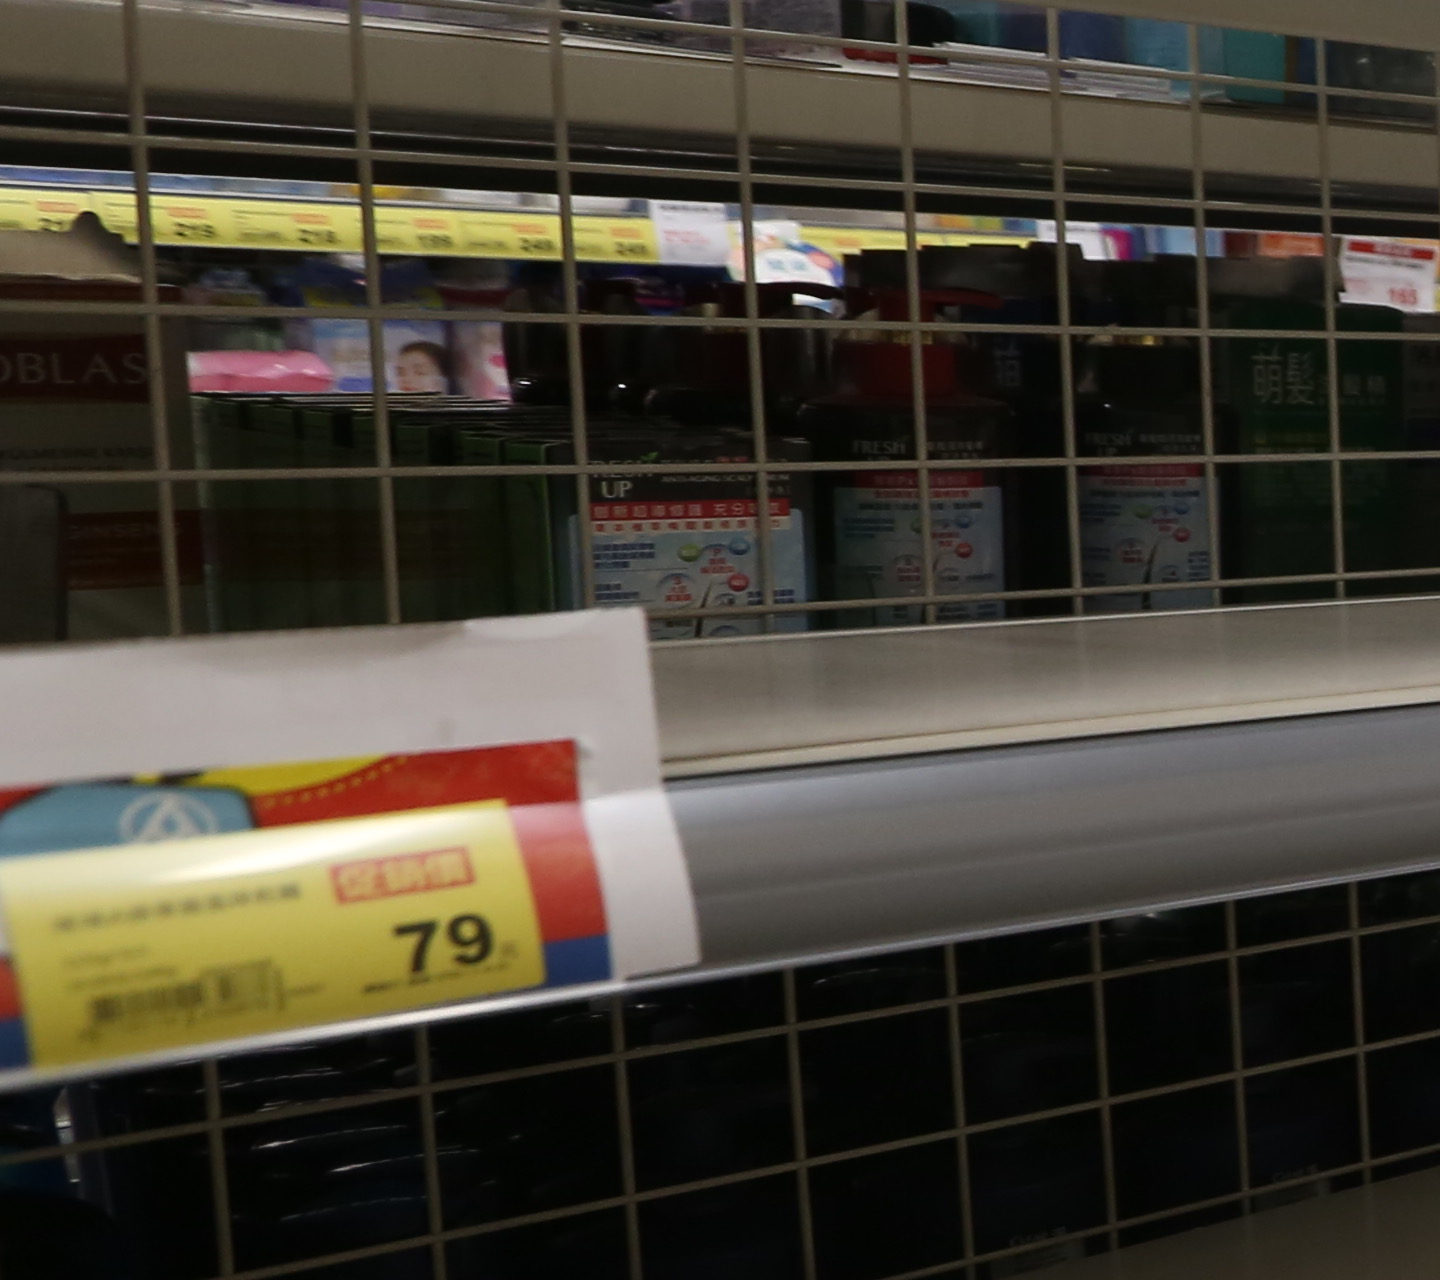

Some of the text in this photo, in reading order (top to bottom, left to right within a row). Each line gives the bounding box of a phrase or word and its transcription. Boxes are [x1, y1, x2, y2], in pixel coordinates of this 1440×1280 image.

[852, 438, 908, 456] FRESH
[600, 480, 634, 499] UP
[392, 913, 494, 973] 79
